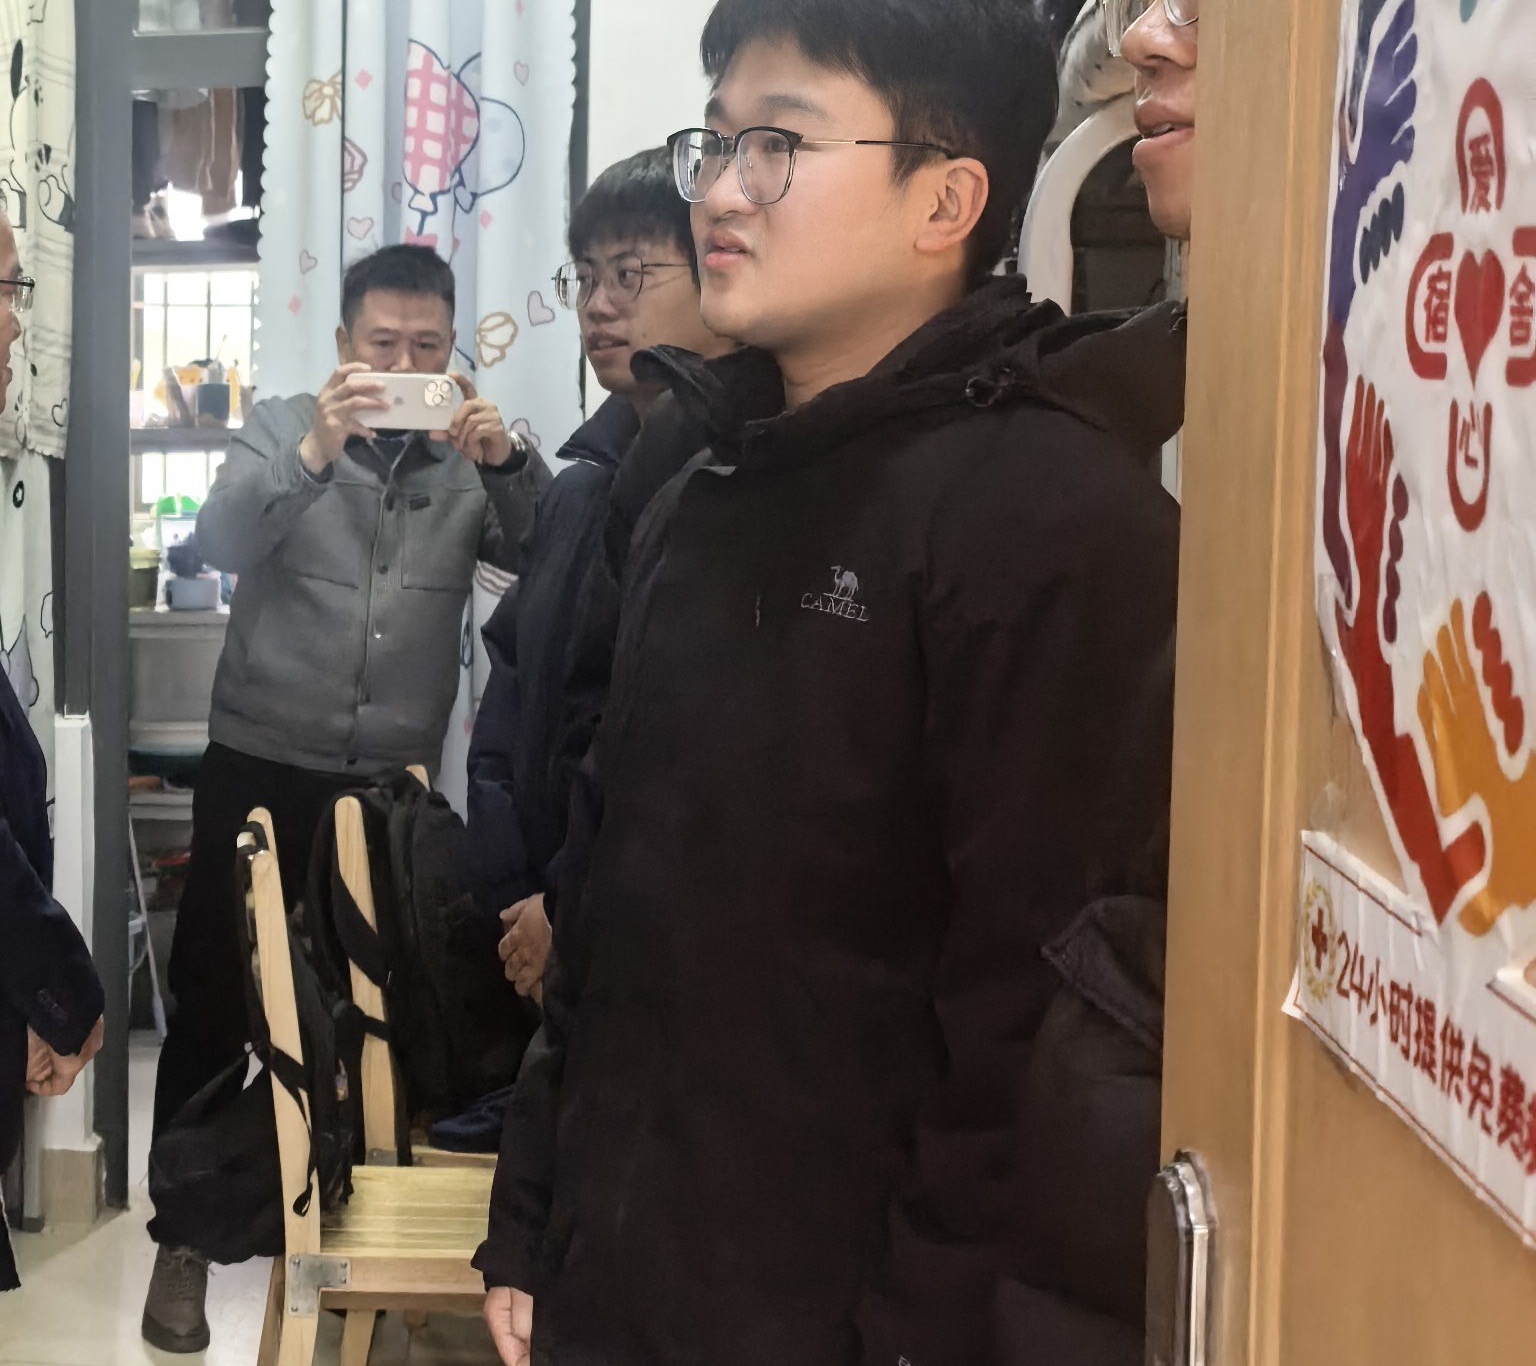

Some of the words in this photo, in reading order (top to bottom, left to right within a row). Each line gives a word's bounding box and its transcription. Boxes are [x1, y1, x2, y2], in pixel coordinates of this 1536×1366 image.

[1423, 264, 1452, 343] 宿
[1509, 262, 1534, 347] 舍
[801, 592, 869, 622] CAMEL
